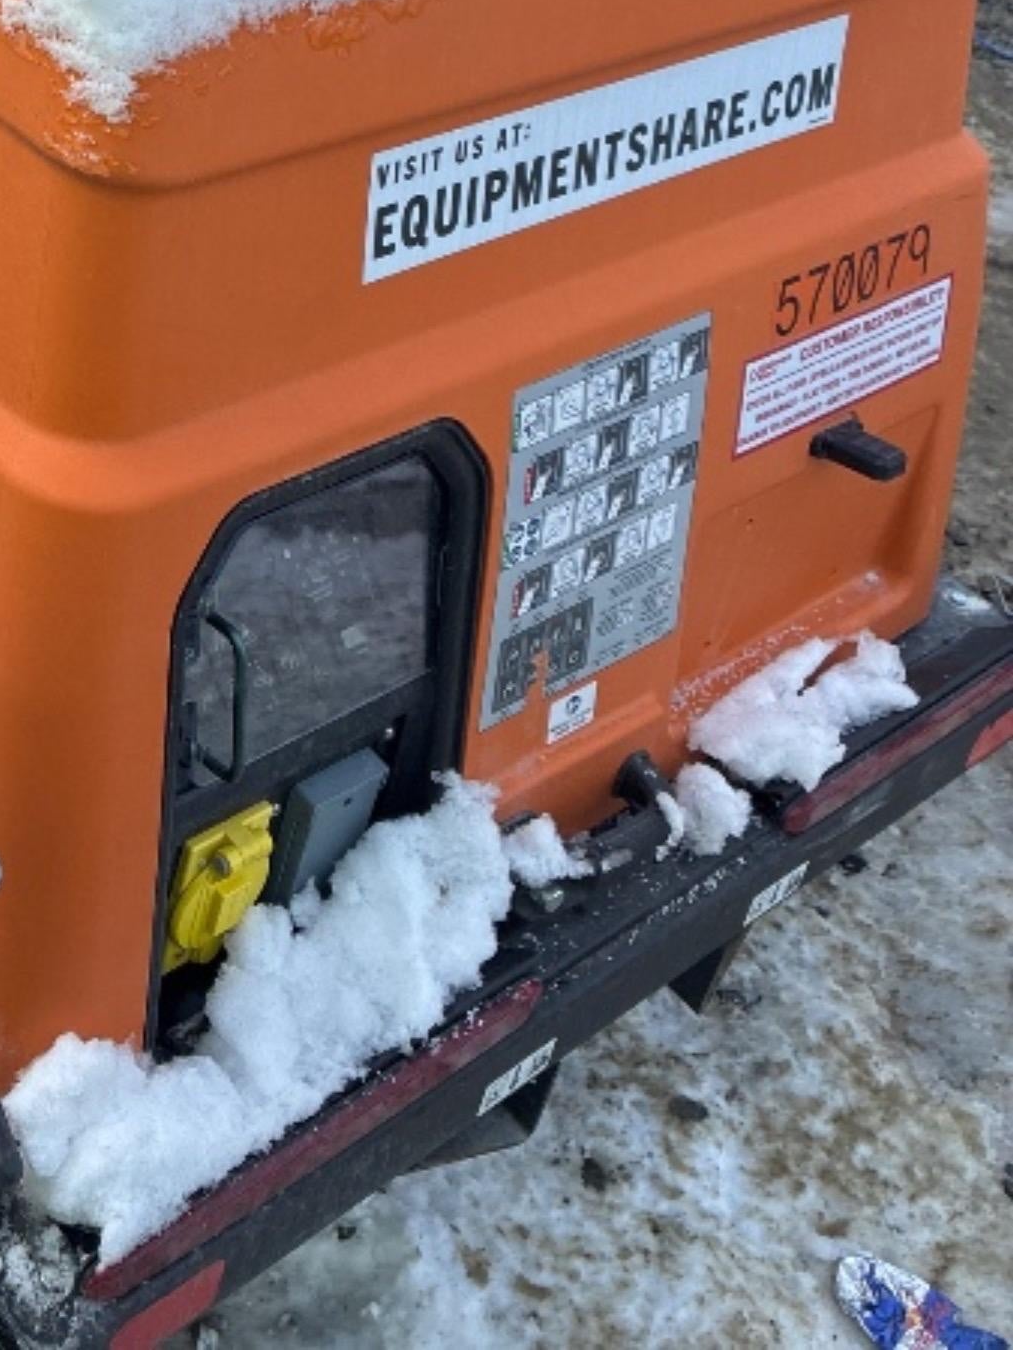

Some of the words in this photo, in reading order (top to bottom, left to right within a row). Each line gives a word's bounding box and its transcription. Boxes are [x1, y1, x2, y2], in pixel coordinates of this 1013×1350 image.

[372, 62, 837, 259] EQUIPMENTSHARE.COM
[377, 147, 443, 190] VISIT
[455, 134, 484, 164] US
[496, 122, 531, 152] AT:
[775, 224, 931, 337] 570079
